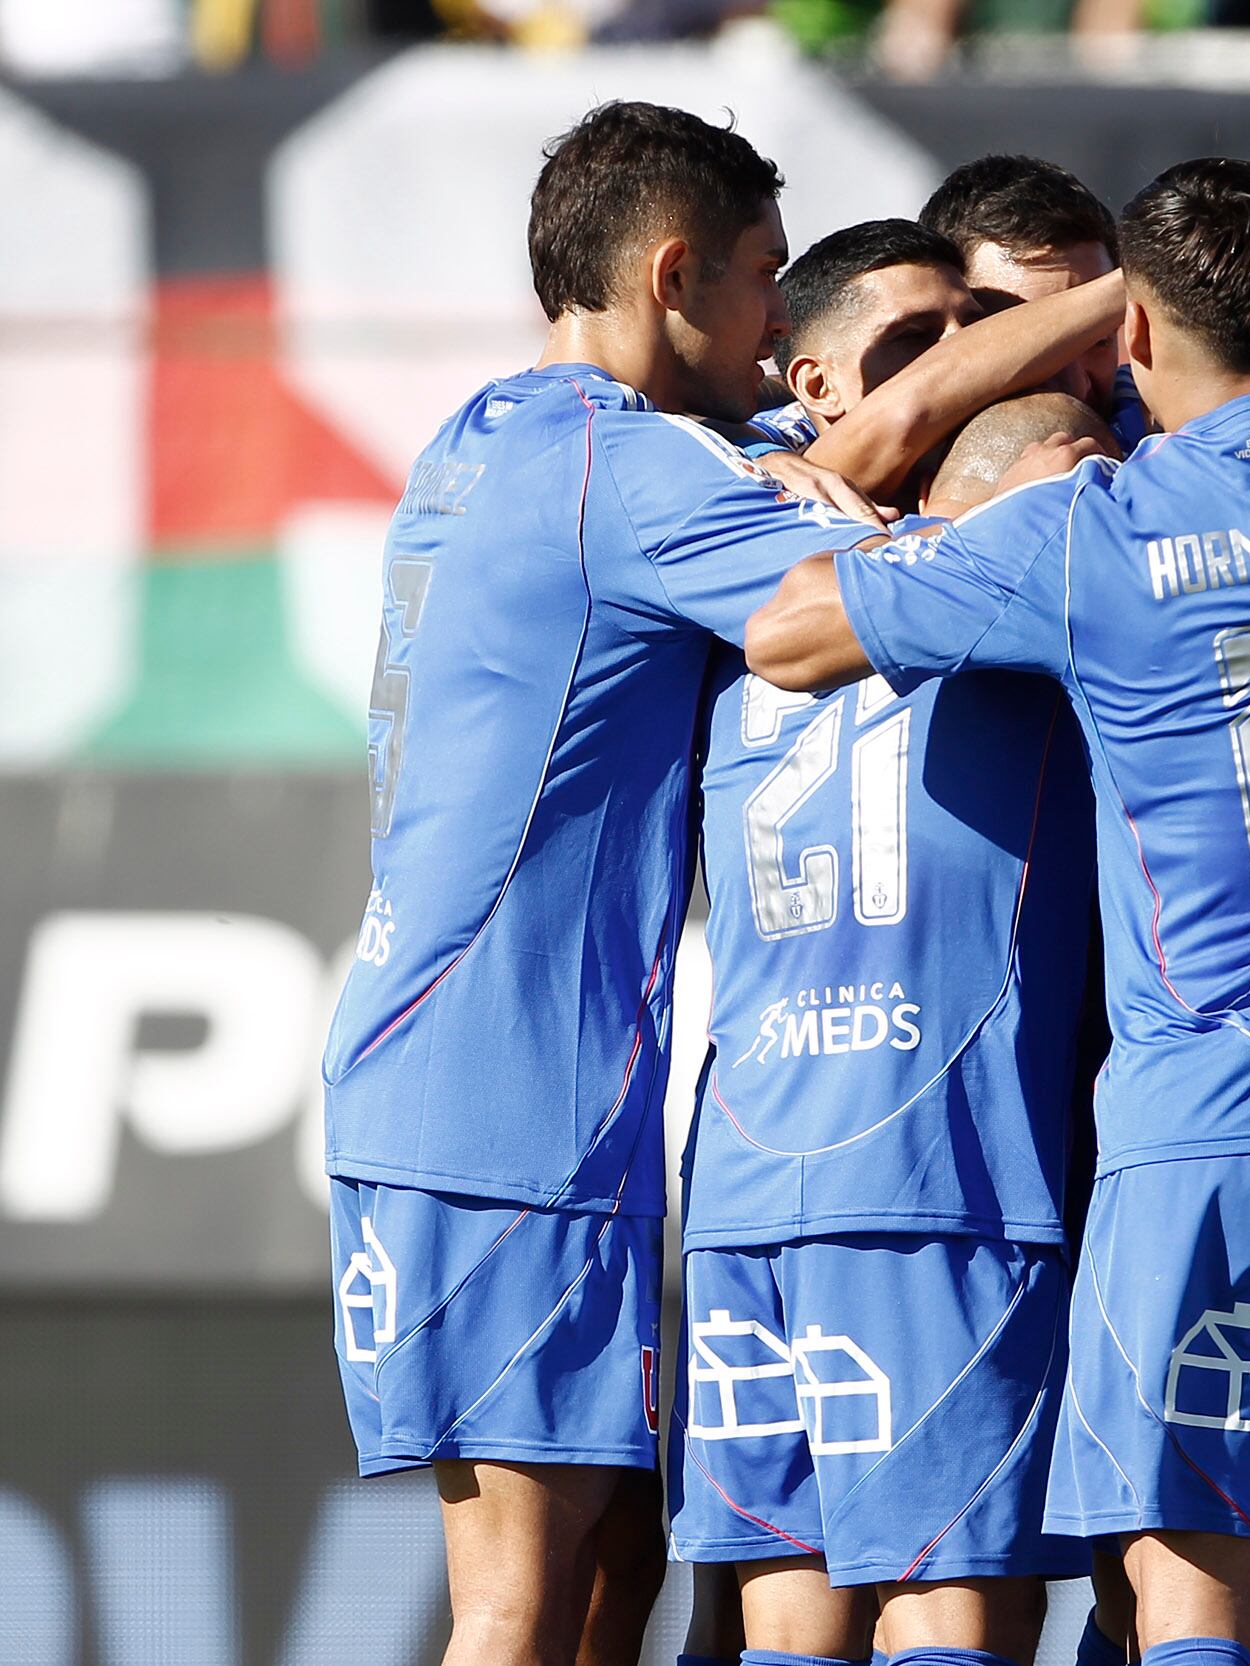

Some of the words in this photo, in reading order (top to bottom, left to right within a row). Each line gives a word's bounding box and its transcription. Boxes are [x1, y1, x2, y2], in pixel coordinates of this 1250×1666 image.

[741, 672, 912, 943] 21
[797, 981, 905, 1006] CLINICA
[780, 1003, 922, 1059] MEDS
